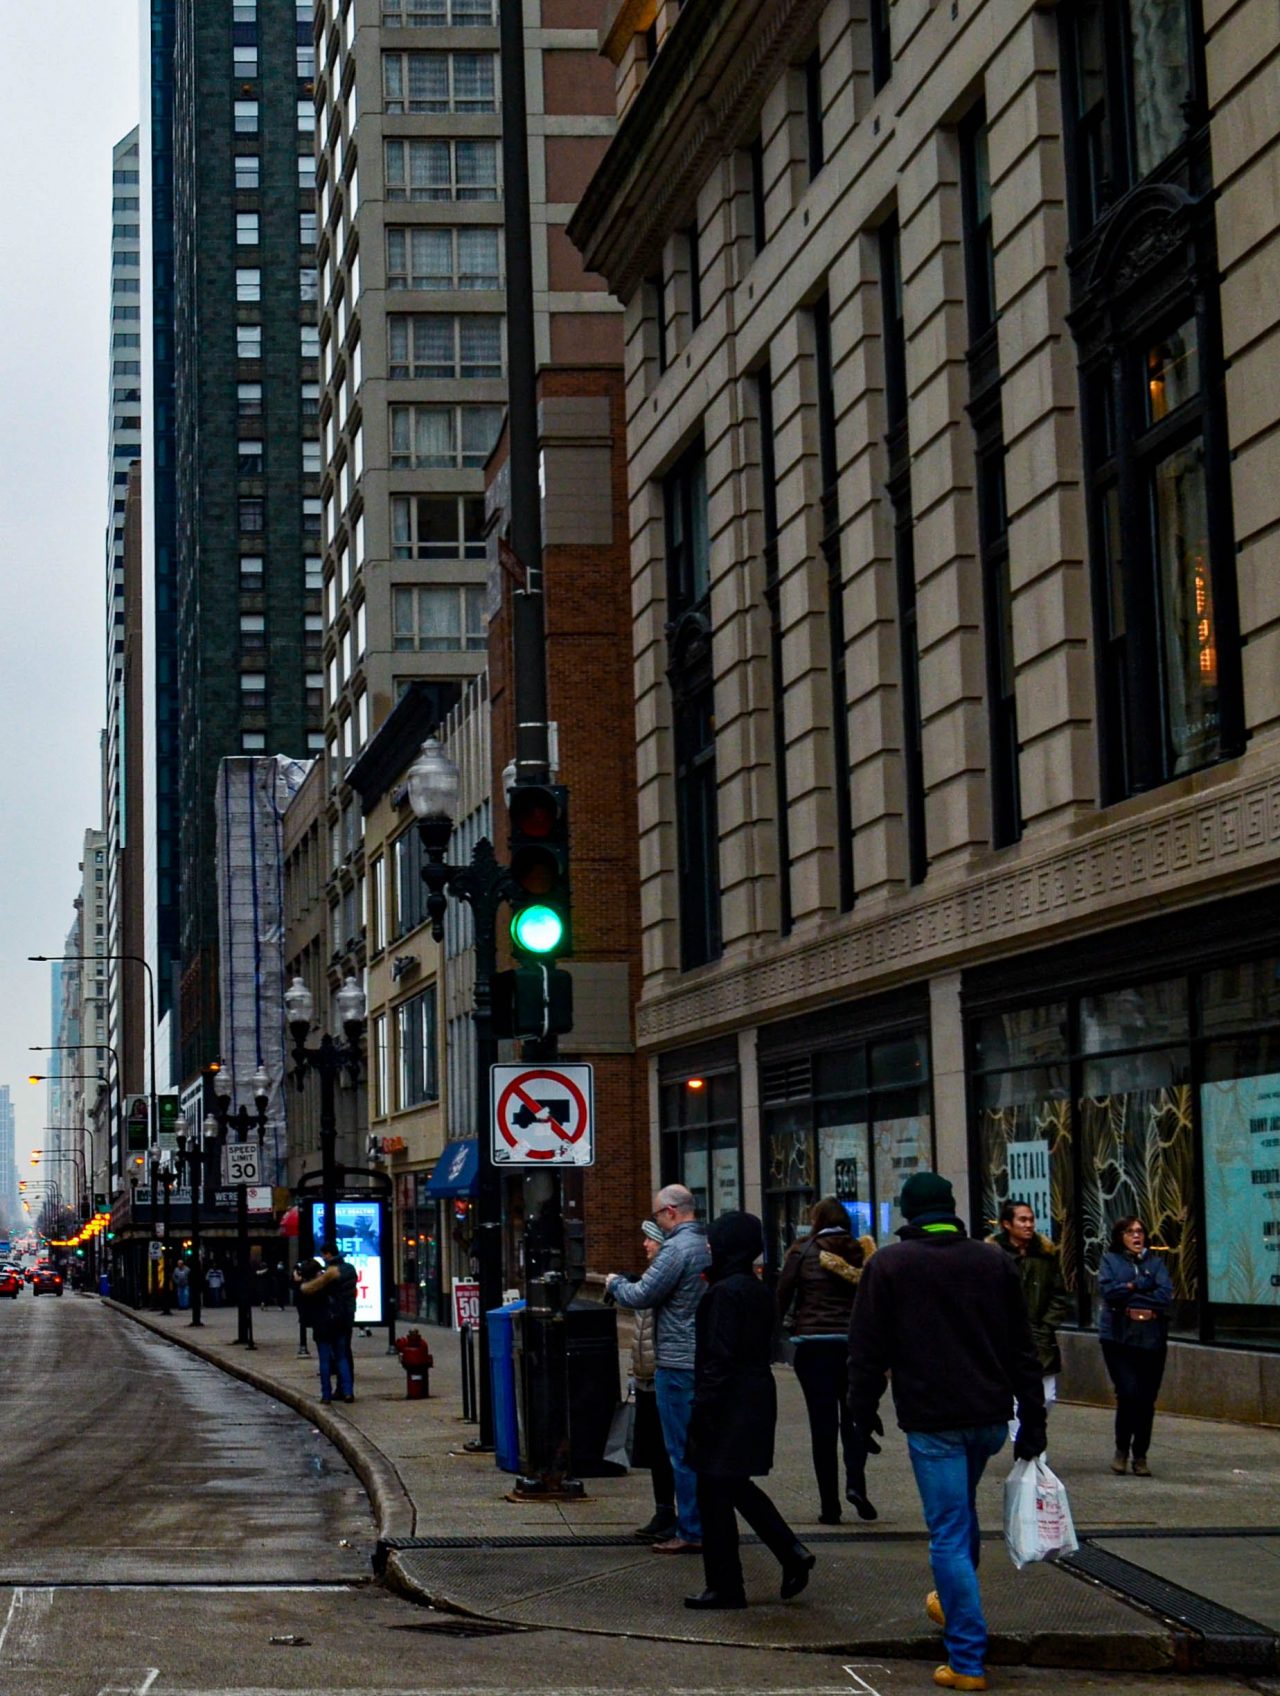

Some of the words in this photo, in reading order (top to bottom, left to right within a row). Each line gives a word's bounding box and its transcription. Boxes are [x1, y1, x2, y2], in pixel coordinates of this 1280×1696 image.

[228, 1144, 256, 1154] SPEED
[231, 1153, 253, 1162] LIMIT
[231, 1163, 256, 1179] 30
[1010, 1151, 1046, 1180] RETAIL
[214, 1191, 239, 1201] WE'RE
[459, 1296, 479, 1318] 50
